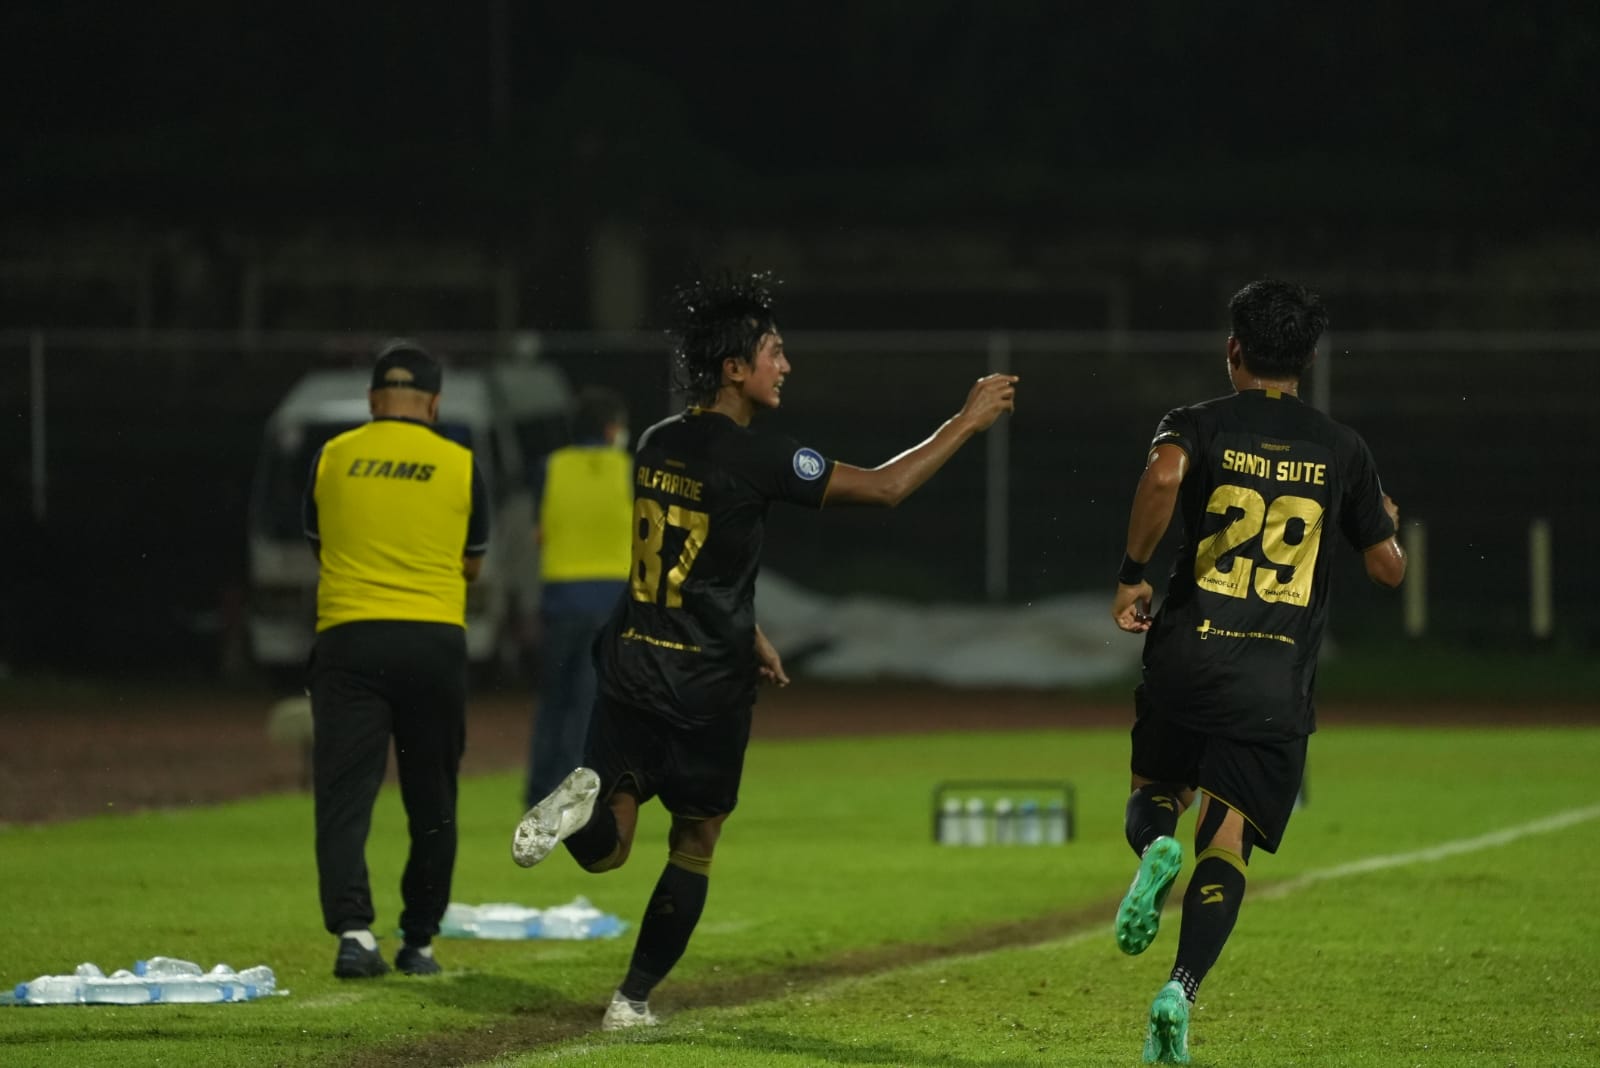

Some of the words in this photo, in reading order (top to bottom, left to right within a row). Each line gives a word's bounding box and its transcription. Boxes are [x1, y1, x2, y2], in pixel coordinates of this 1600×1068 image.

[347, 458, 437, 482] ETAMS
[637, 466, 703, 501] ALFARIZIE
[1222, 449, 1270, 479] SANDI
[1276, 461, 1326, 485] SUTE
[630, 497, 709, 609] 87
[1194, 484, 1325, 608] 29
